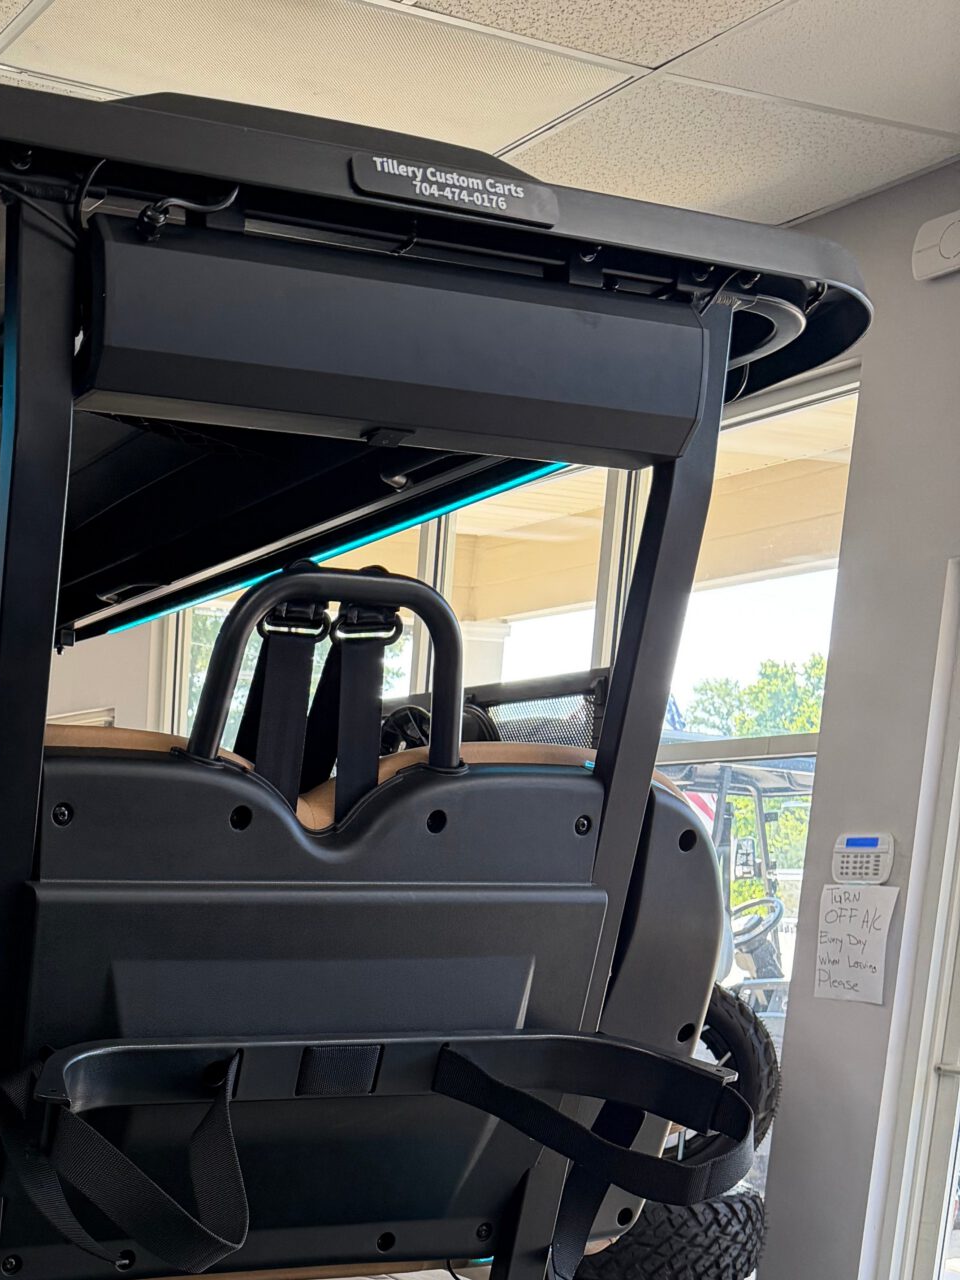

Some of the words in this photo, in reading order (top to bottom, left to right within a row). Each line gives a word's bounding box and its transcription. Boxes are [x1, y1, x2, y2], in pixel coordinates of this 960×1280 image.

[372, 156, 424, 182] Tillery
[426, 167, 483, 190] Custom
[485, 178, 525, 198] Carts
[412, 180, 508, 210] 704-474-0176
[824, 907, 859, 924] OFF
[861, 906, 882, 934] A/C
[846, 933, 868, 955] Day
[817, 968, 860, 993] Please
